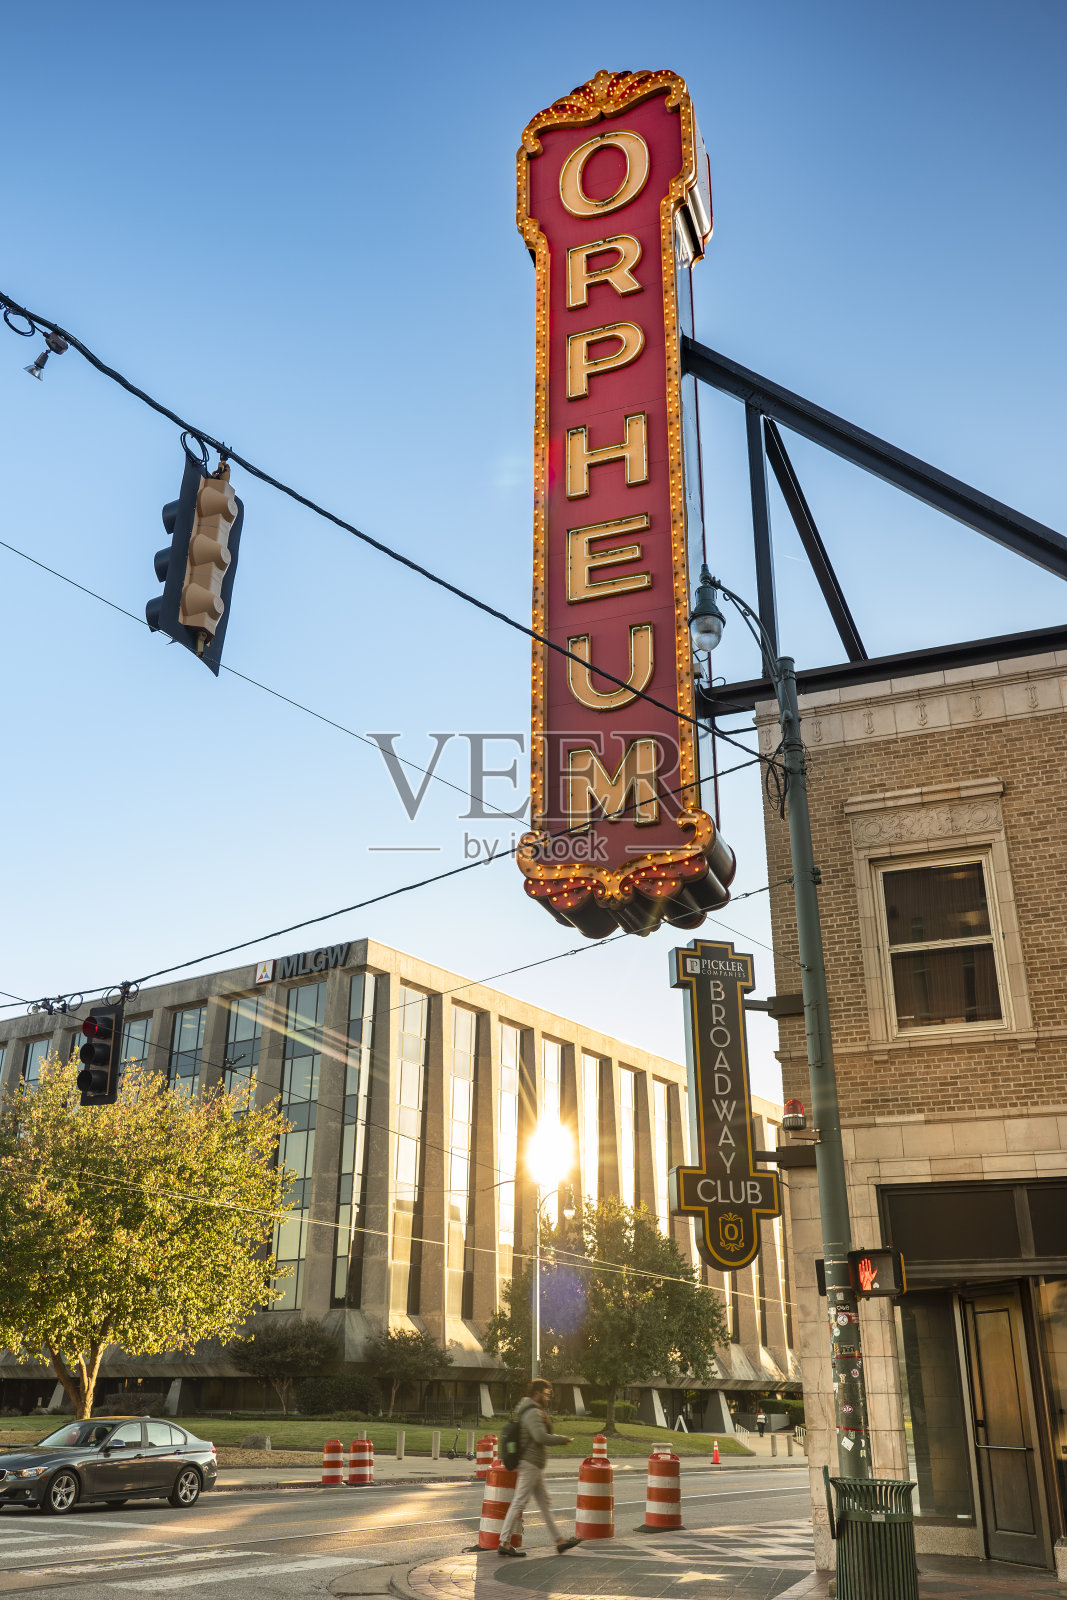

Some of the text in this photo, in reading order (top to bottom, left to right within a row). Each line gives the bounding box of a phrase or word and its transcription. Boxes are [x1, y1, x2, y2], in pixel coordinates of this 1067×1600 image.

[559, 129, 661, 836] ORPHEUM
[280, 942, 351, 979] MLGW
[701, 959, 744, 972] PICKLER
[701, 969, 746, 978] COMPANIES
[710, 979, 737, 1174] BROADWAY
[697, 1179, 762, 1204] CLUB
